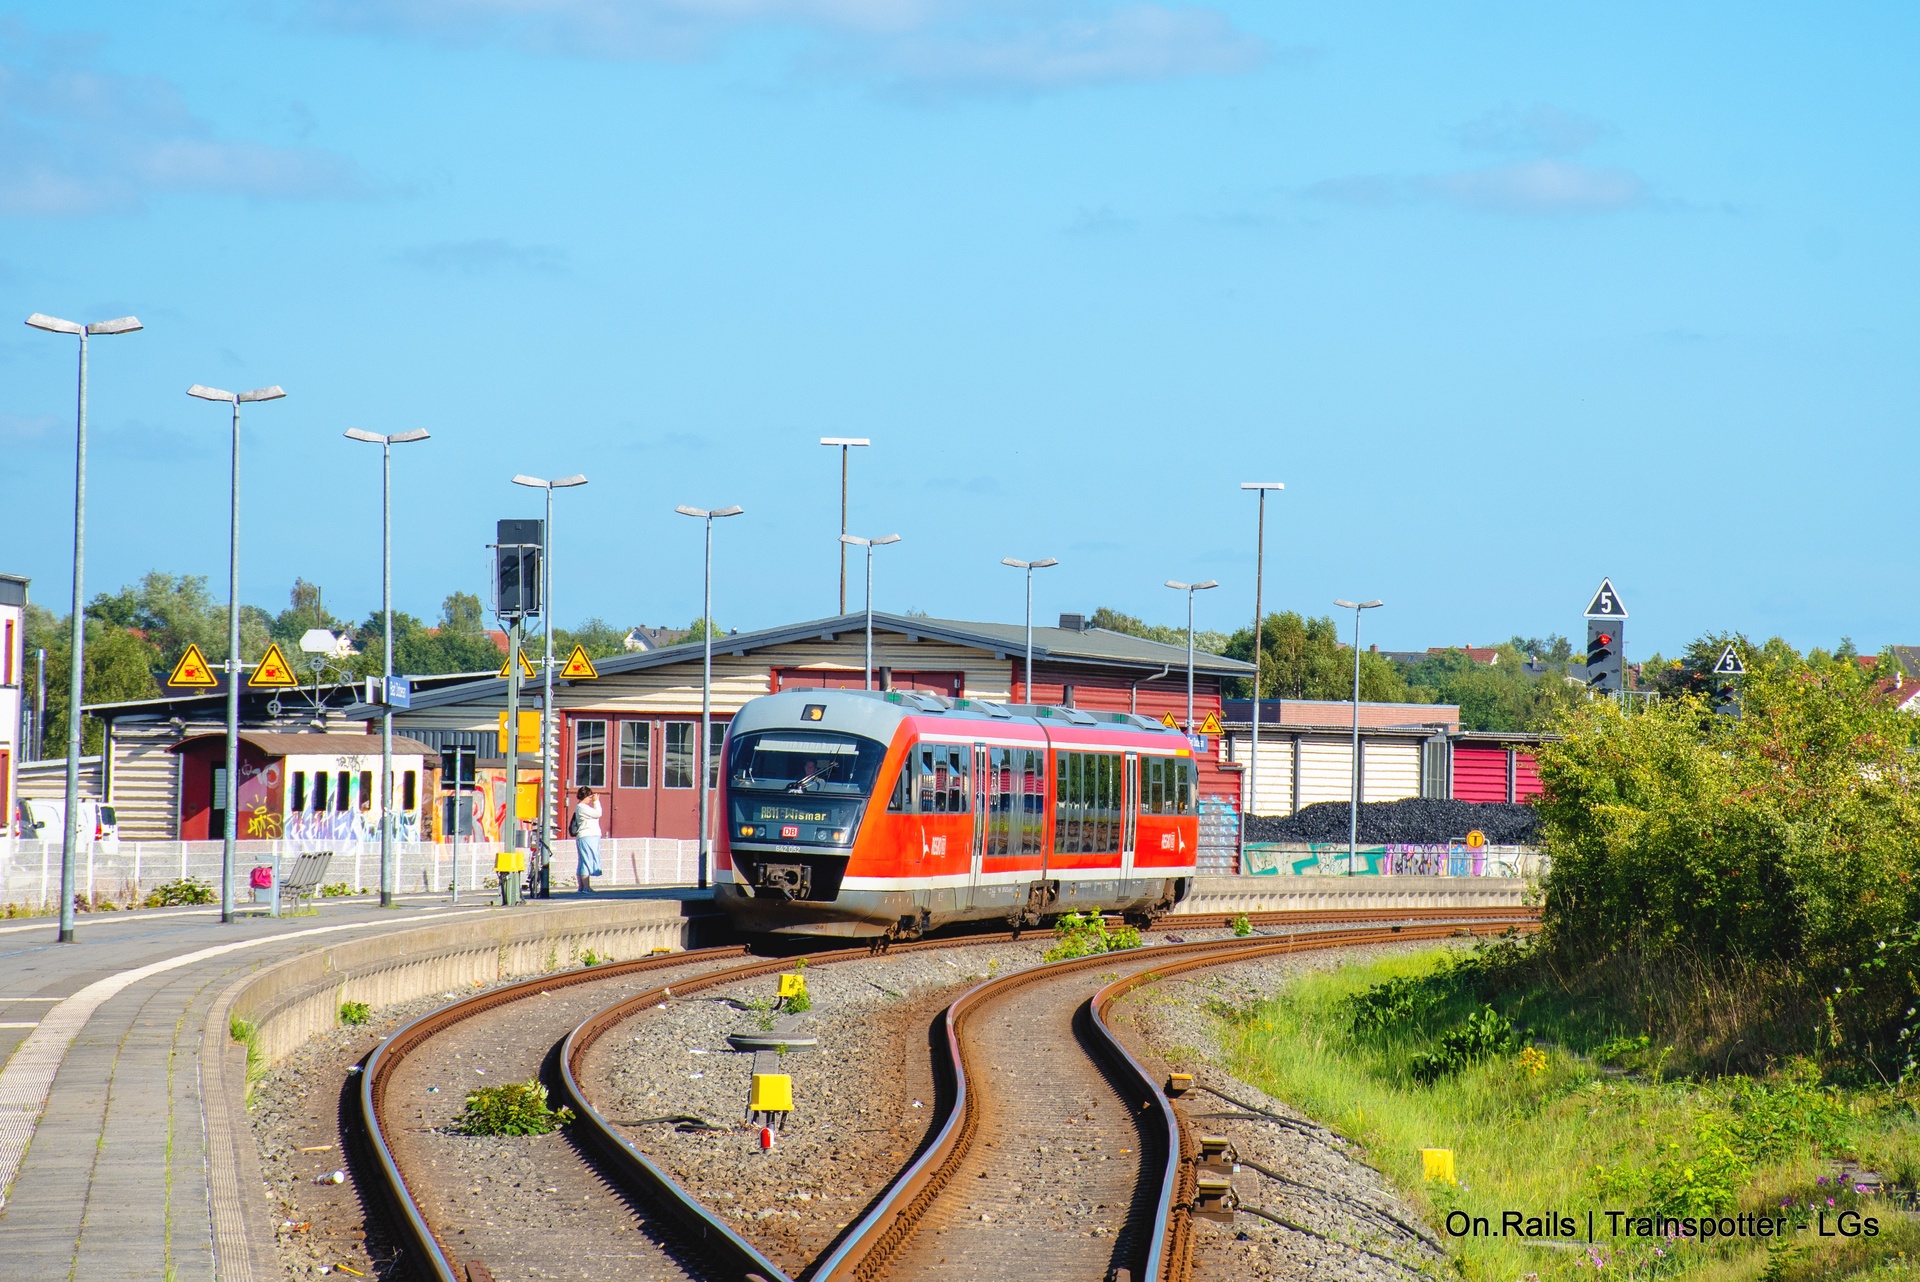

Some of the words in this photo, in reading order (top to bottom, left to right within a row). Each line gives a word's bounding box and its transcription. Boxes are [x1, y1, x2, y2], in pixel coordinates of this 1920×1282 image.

[1601, 592, 1612, 613] 5
[1726, 654, 1735, 670] 5
[784, 808, 827, 821] Wismar
[784, 828, 796, 836] DB
